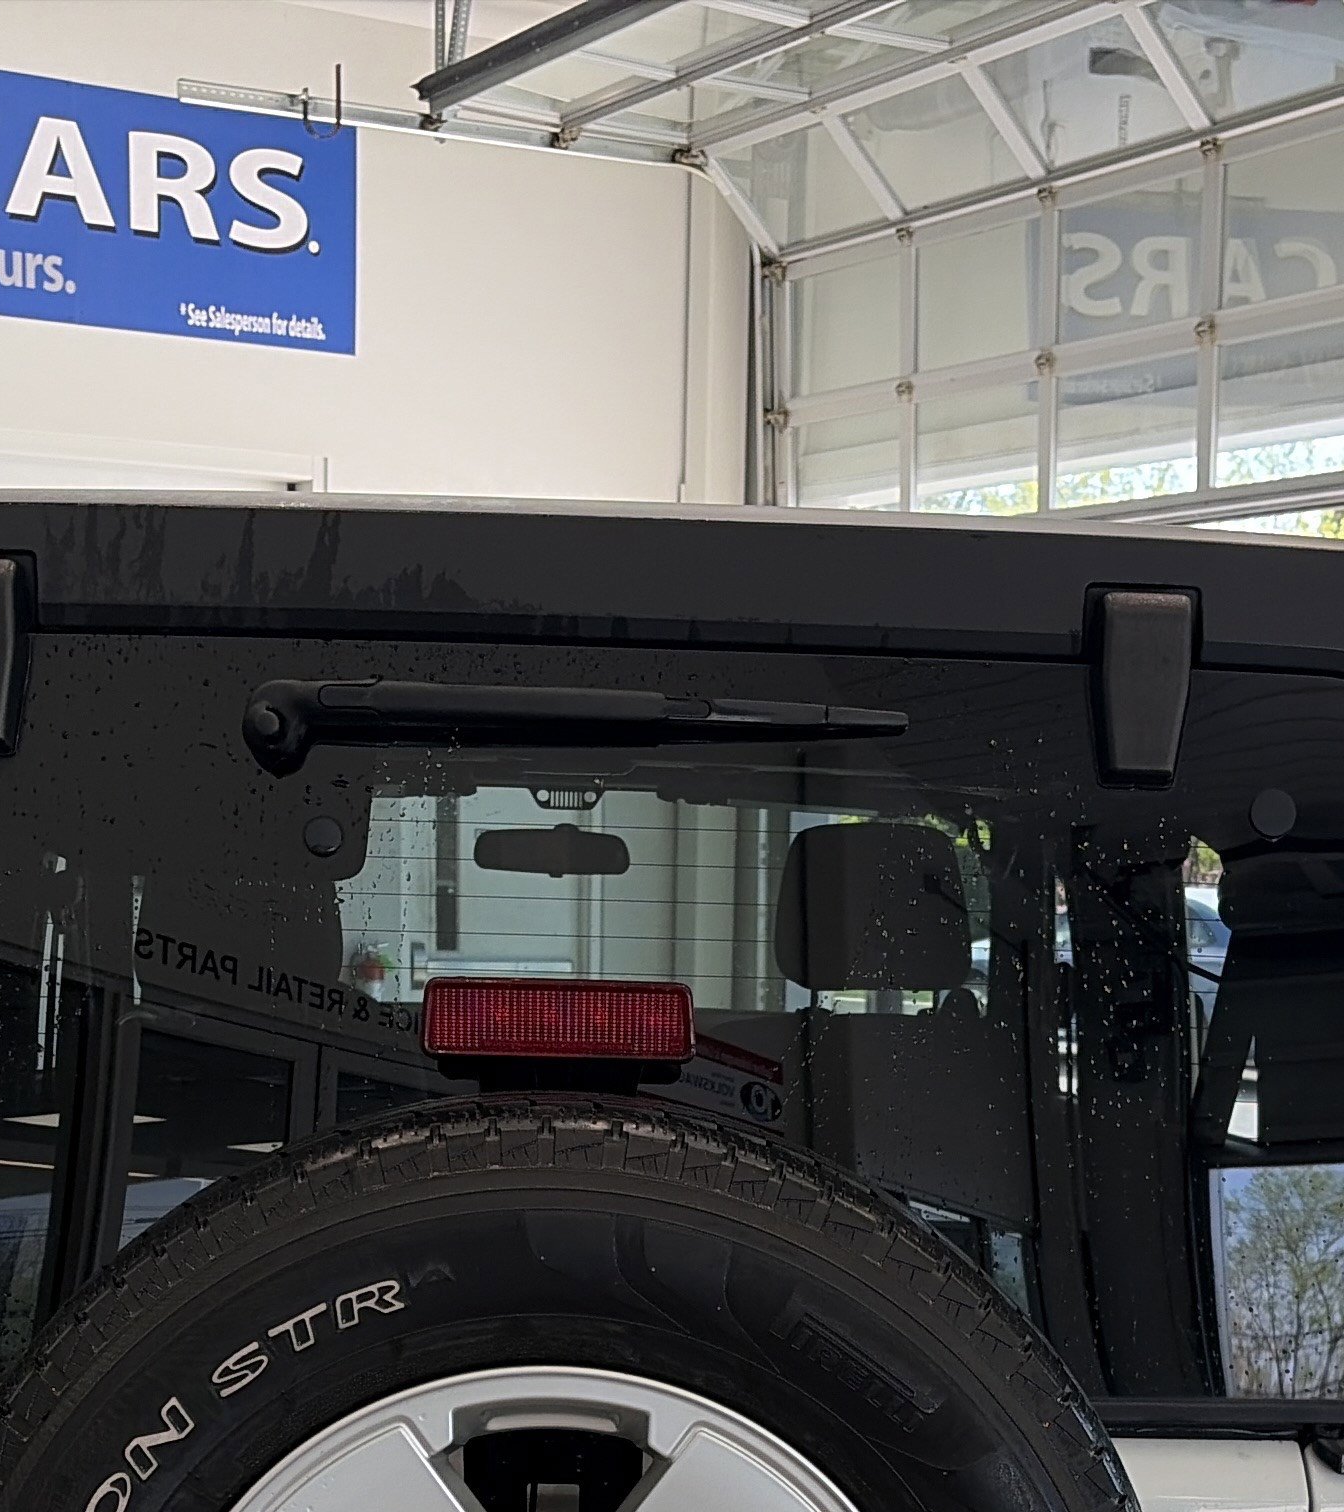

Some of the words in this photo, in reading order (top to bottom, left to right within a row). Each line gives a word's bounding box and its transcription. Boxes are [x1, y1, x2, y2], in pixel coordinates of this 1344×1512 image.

[208, 305, 270, 336] Salesperson
[271, 311, 287, 336] for
[288, 314, 326, 340] details.
[212, 1278, 407, 1398] STR
